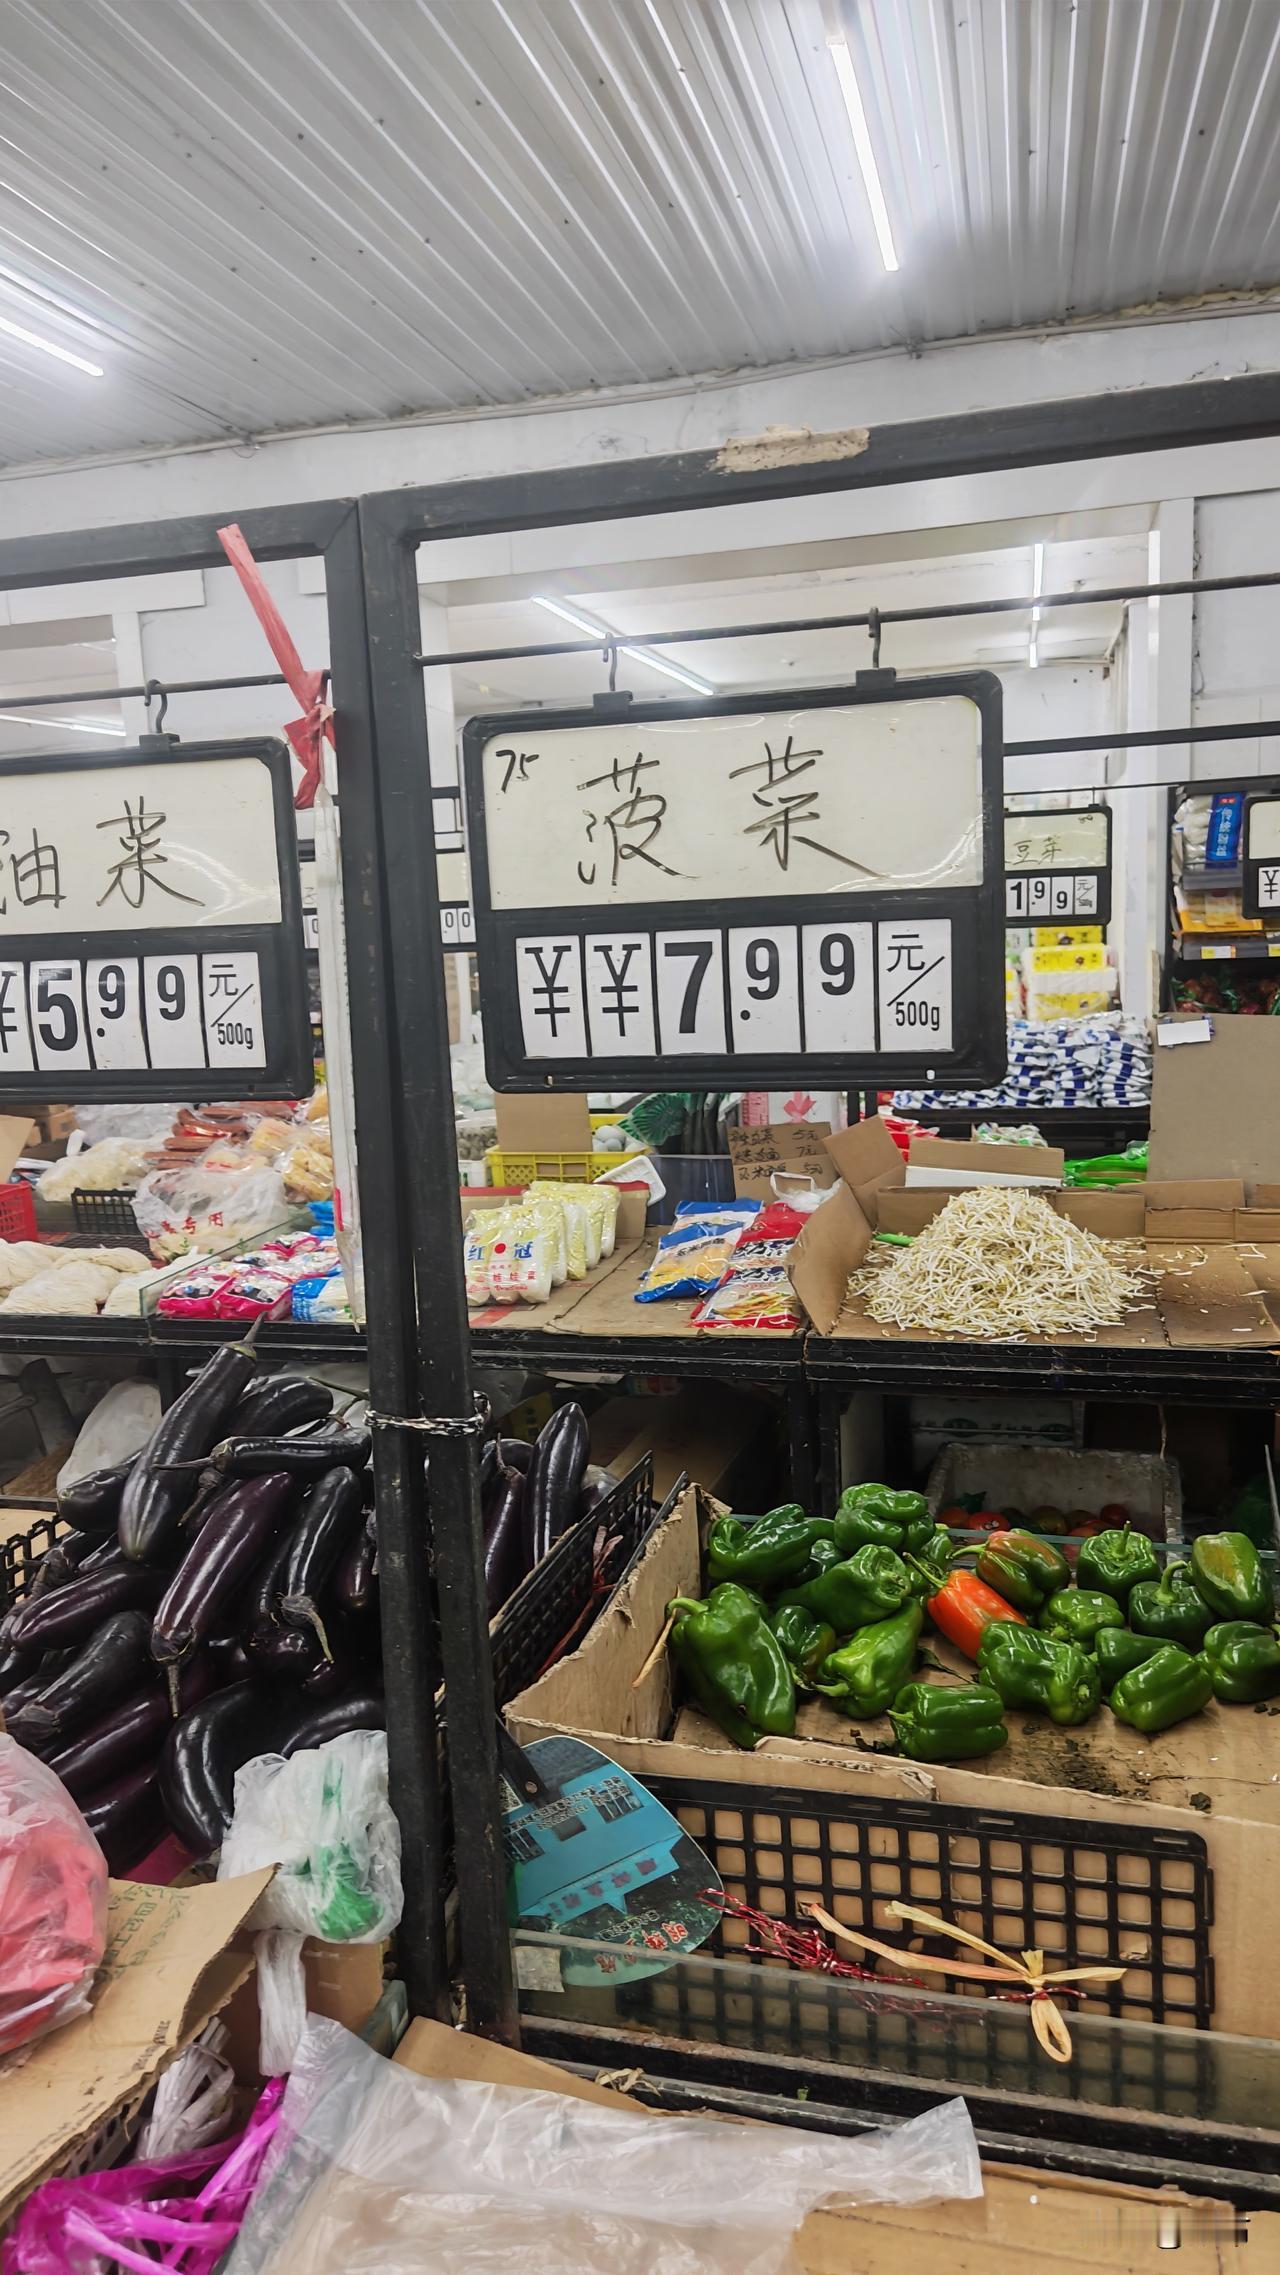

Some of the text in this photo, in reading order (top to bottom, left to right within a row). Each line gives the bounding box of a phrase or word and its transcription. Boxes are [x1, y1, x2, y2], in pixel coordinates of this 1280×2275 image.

[0, 795, 205, 915] 油菜
[576, 736, 889, 887] 菠菜
[1004, 834, 1062, 866] 豆芽
